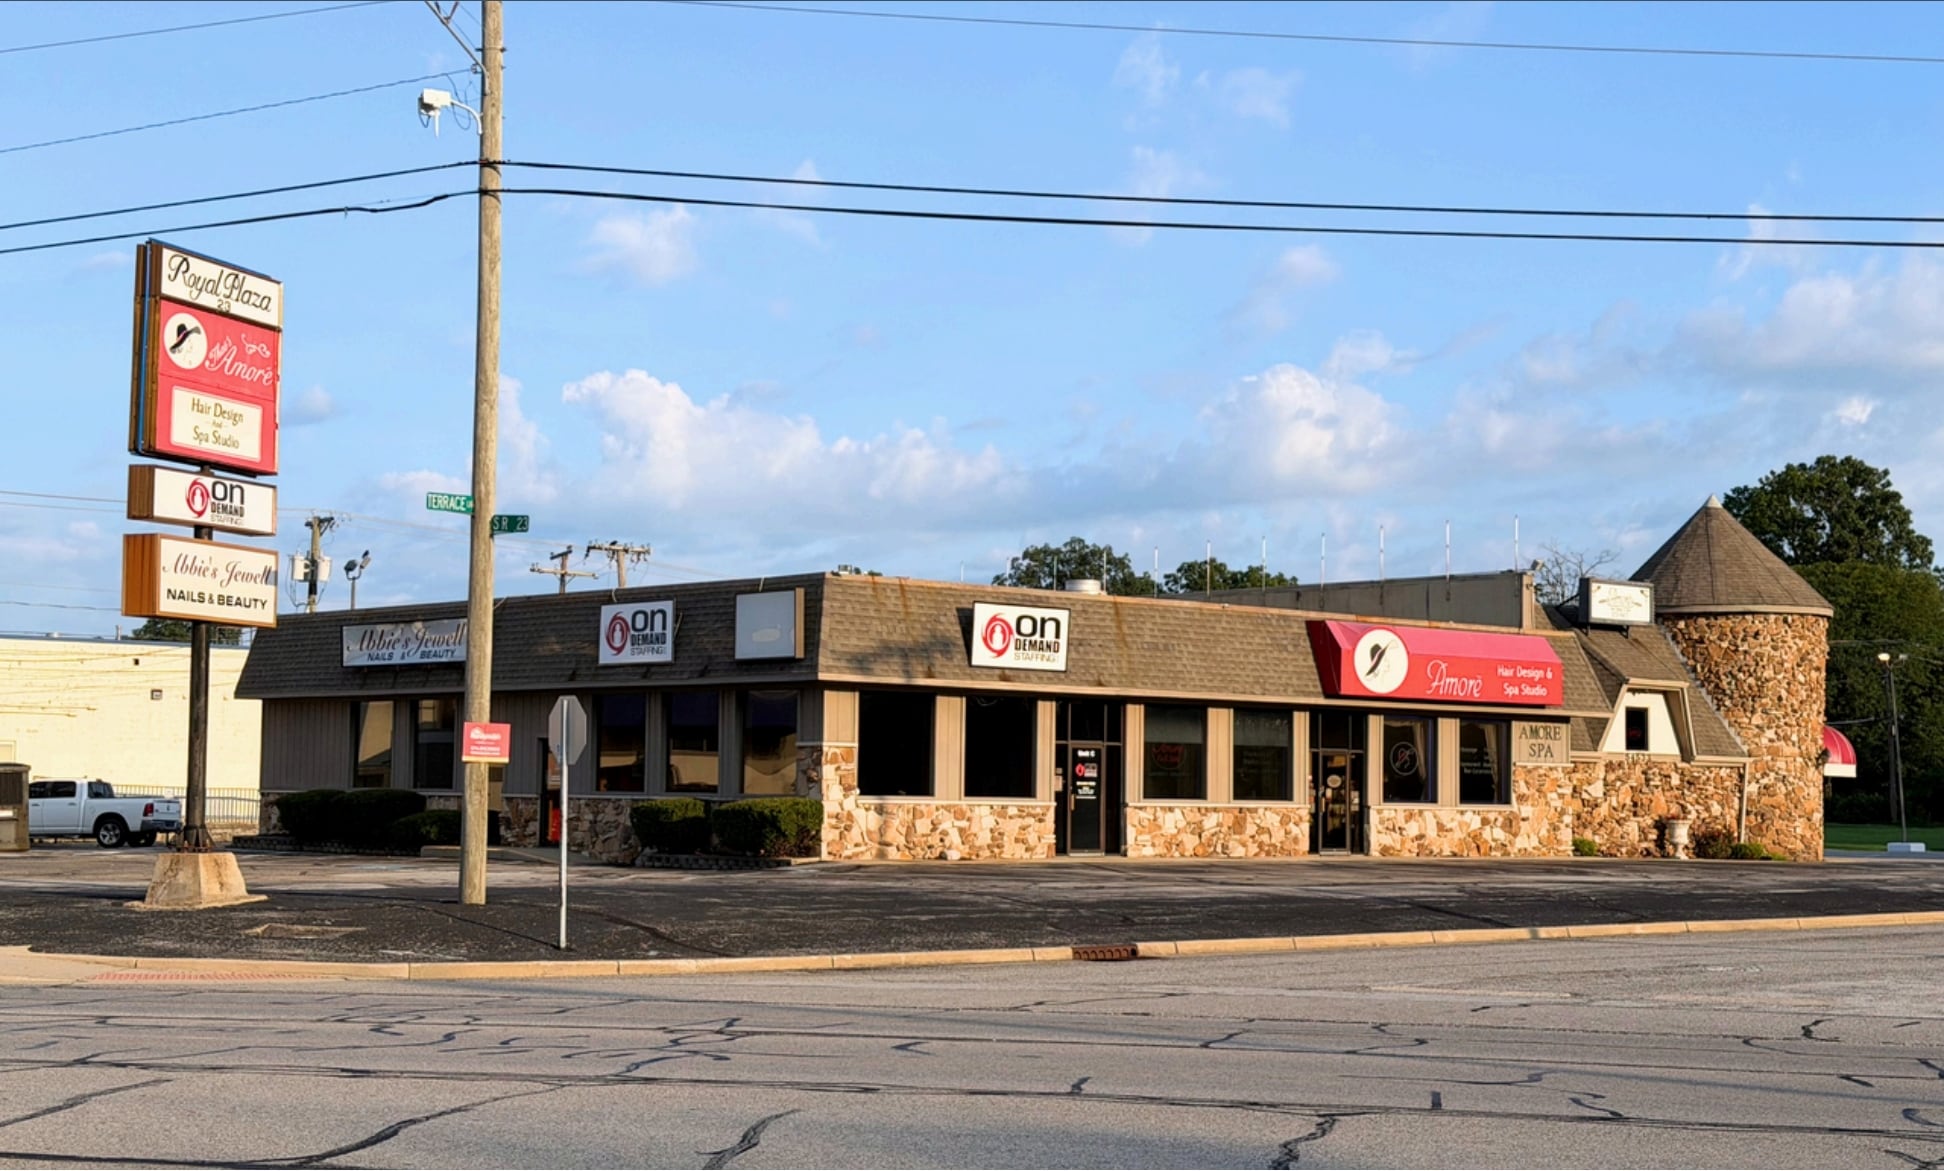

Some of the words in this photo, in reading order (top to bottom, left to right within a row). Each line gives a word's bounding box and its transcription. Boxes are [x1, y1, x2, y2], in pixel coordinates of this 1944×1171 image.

[168, 254, 223, 300] Royal
[223, 272, 272, 312] Plaza
[191, 397, 211, 414] Hair
[213, 402, 244, 426] Design
[193, 425, 209, 445] Spa
[212, 430, 240, 449] Studio
[211, 480, 245, 505] on
[211, 501, 244, 518] DEMAND
[428, 494, 467, 511] TERRACE
[516, 516, 529, 530] 23
[162, 552, 219, 579] Abbie's
[166, 588, 205, 603] NAILS
[207, 593, 214, 604] &
[217, 594, 268, 610] BEAUTY
[631, 608, 667, 632] on
[1015, 614, 1061, 640] on
[347, 627, 411, 652] Abbie's
[631, 632, 667, 646] DEMAND
[1014, 638, 1060, 654] DEMAND
[367, 652, 394, 662] NAILS
[419, 648, 456, 660] BEAUTY
[1497, 664, 1514, 677] Hair
[1517, 666, 1544, 682] Design
[1546, 667, 1552, 680] &
[1503, 682, 1519, 698] Spa
[1521, 683, 1547, 696] Studio
[1519, 724, 1562, 741] AMORE
[1529, 743, 1554, 758] SPA
